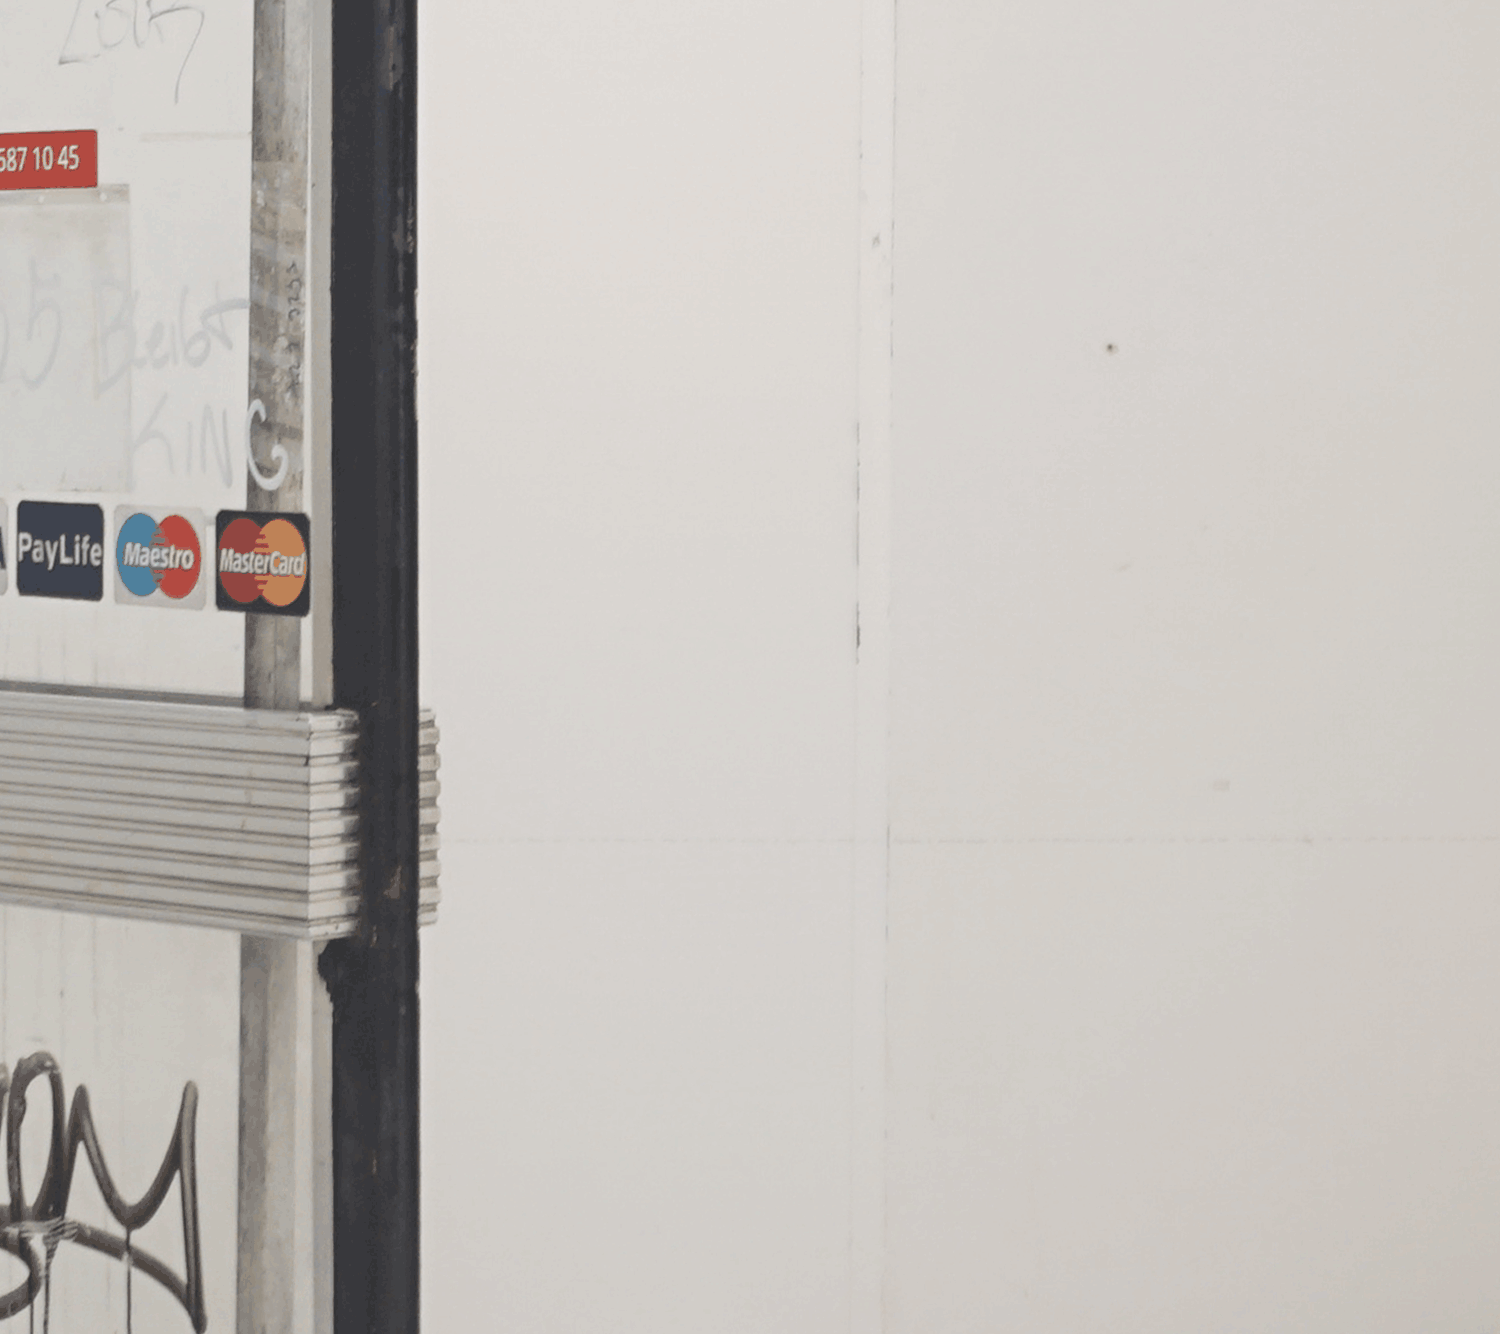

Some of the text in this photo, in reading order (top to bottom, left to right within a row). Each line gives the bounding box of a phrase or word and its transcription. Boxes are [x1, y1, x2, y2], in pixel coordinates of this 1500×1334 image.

[32, 146, 53, 170] 10
[57, 145, 79, 170] 45
[18, 531, 103, 571] PayLife
[122, 541, 195, 571] Maestro
[219, 547, 307, 576] MasterCard
